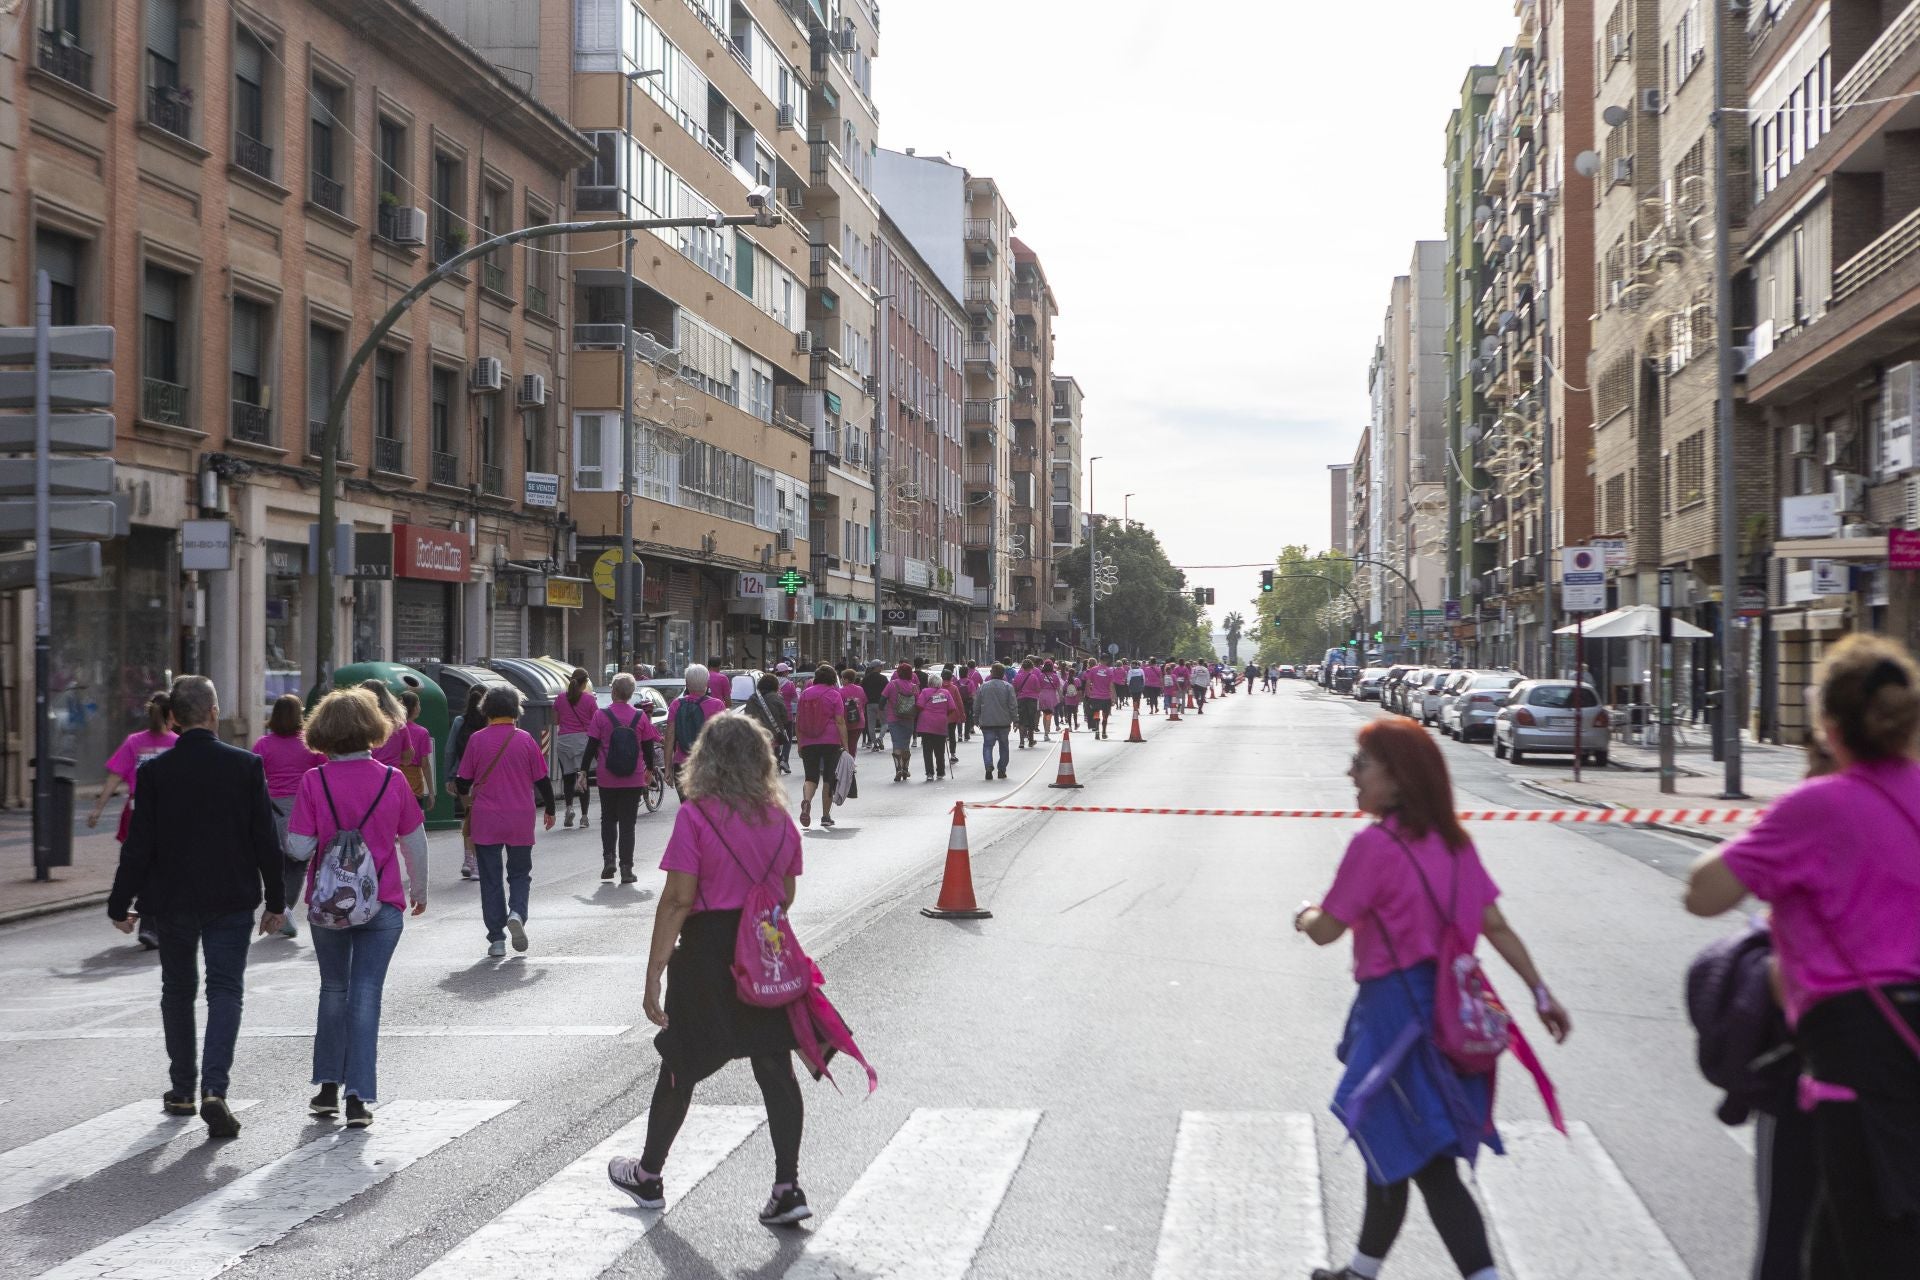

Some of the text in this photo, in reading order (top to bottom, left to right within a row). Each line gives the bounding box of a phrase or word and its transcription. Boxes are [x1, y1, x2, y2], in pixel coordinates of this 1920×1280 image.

[528, 483, 556, 493] SE VENDE
[184, 540, 229, 549] MI-BO-TA
[742, 576, 764, 594] 12h
